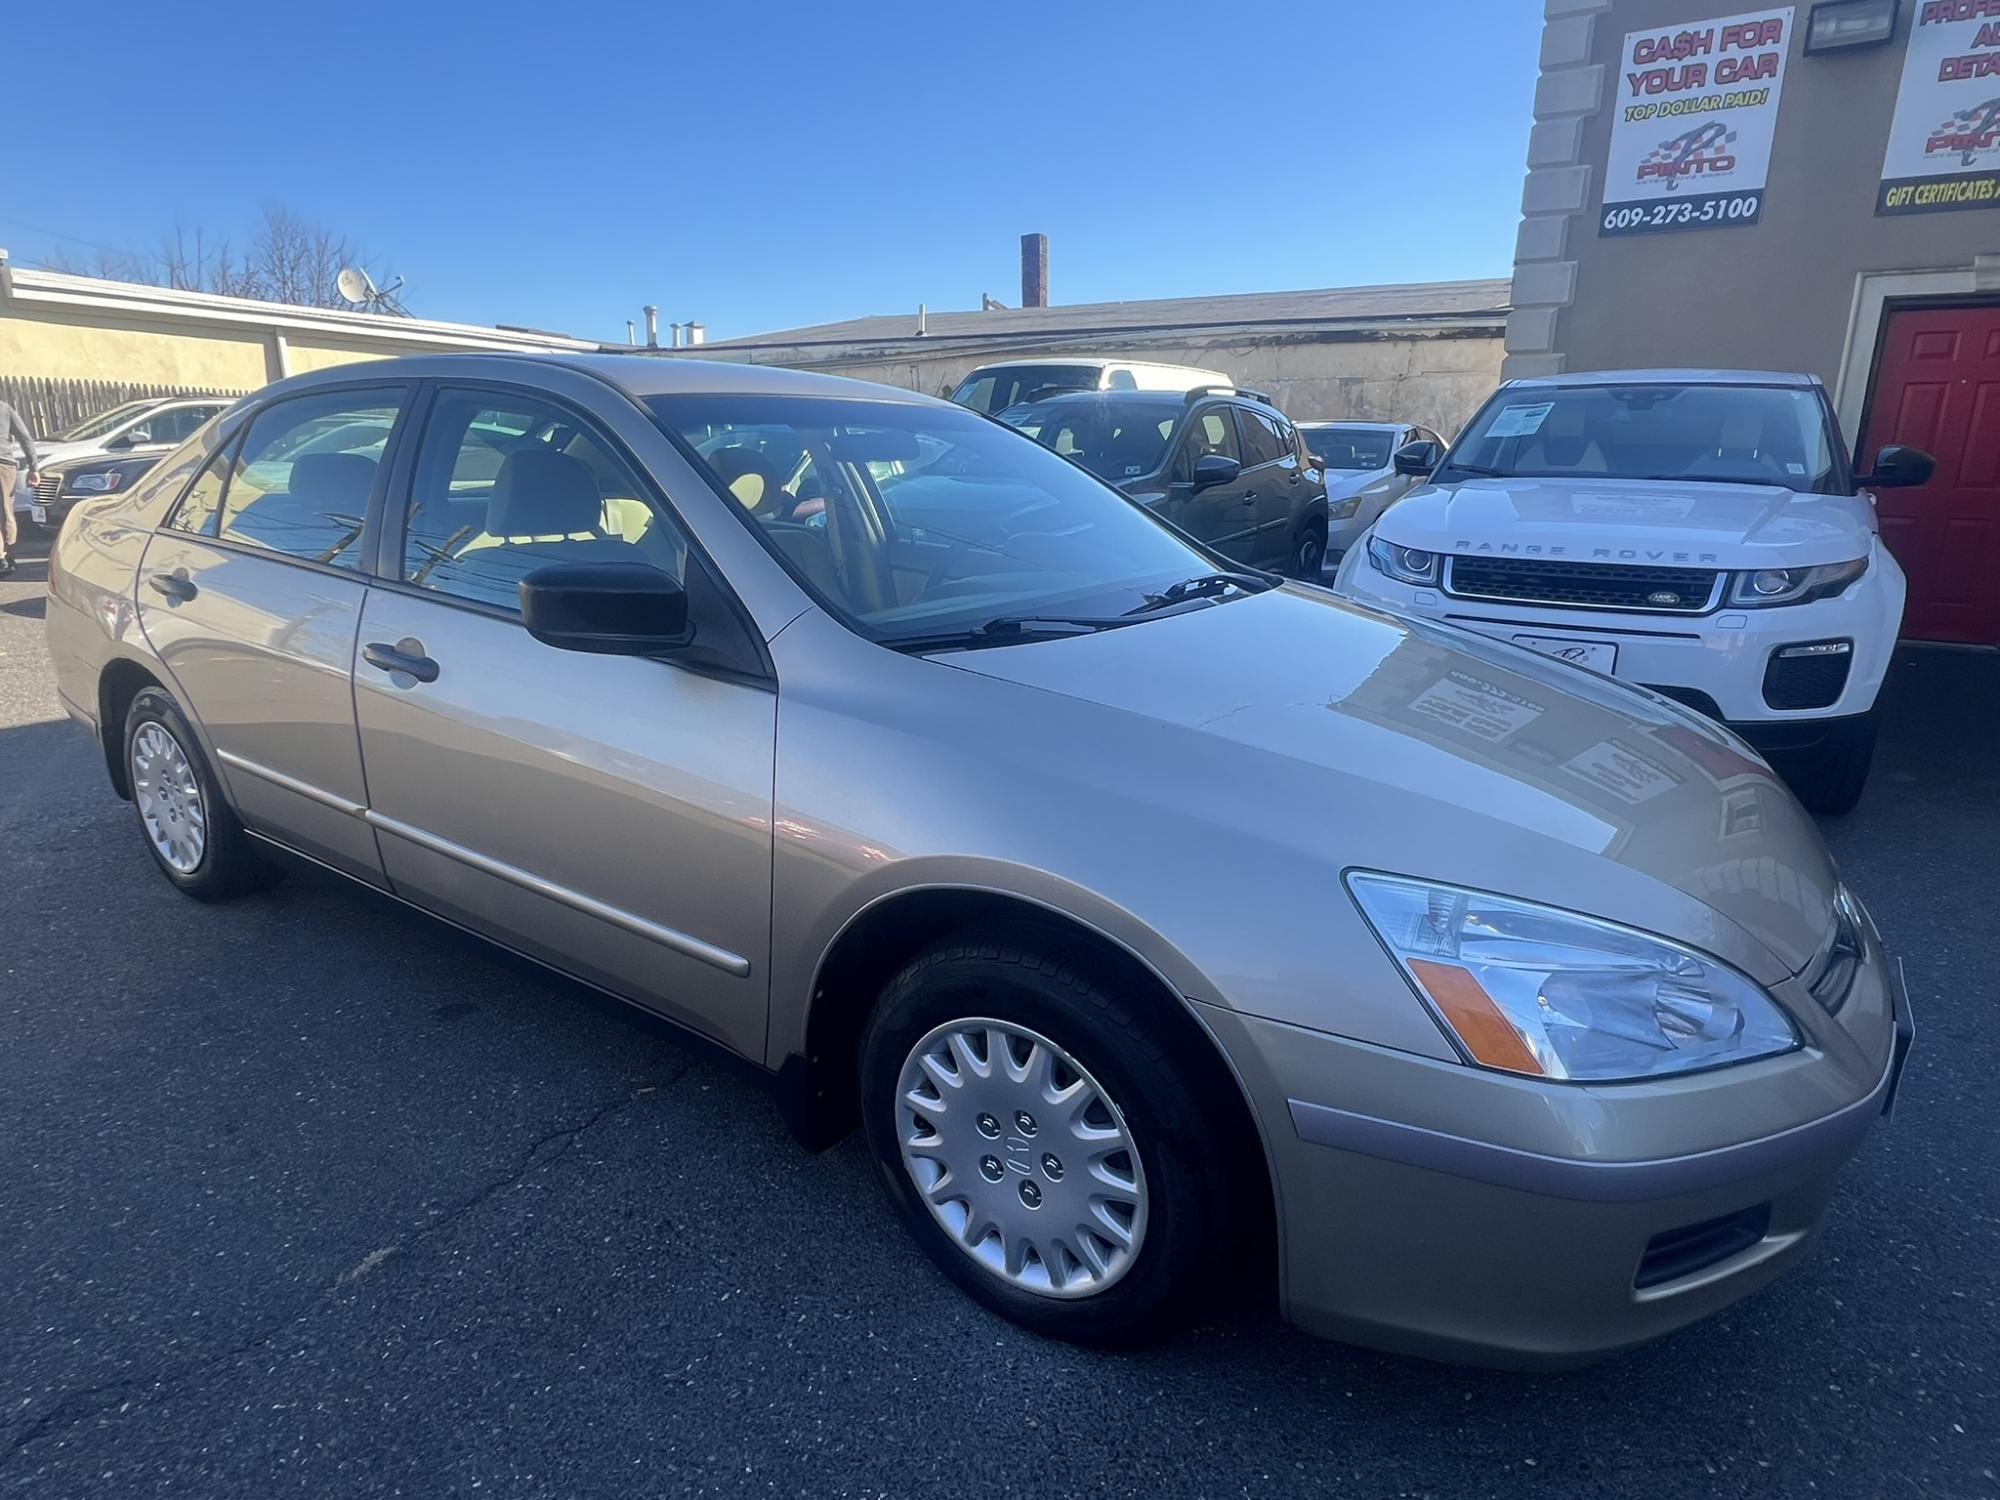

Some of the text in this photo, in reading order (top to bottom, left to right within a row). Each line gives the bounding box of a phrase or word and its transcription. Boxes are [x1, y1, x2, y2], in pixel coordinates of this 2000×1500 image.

[1633, 18, 1783, 65] CA$H FOR
[1627, 52, 1779, 97] YOUR CAR
[1625, 88, 1770, 122] TOP DOLLAR PAID!
[1637, 155, 1735, 180] PINTO
[1886, 185, 1915, 208] GIFT
[1915, 179, 1996, 205] CERTIFICATES
[1604, 196, 1758, 229] 609-273-5100
[1455, 540, 1718, 563] RANGE ROVER
